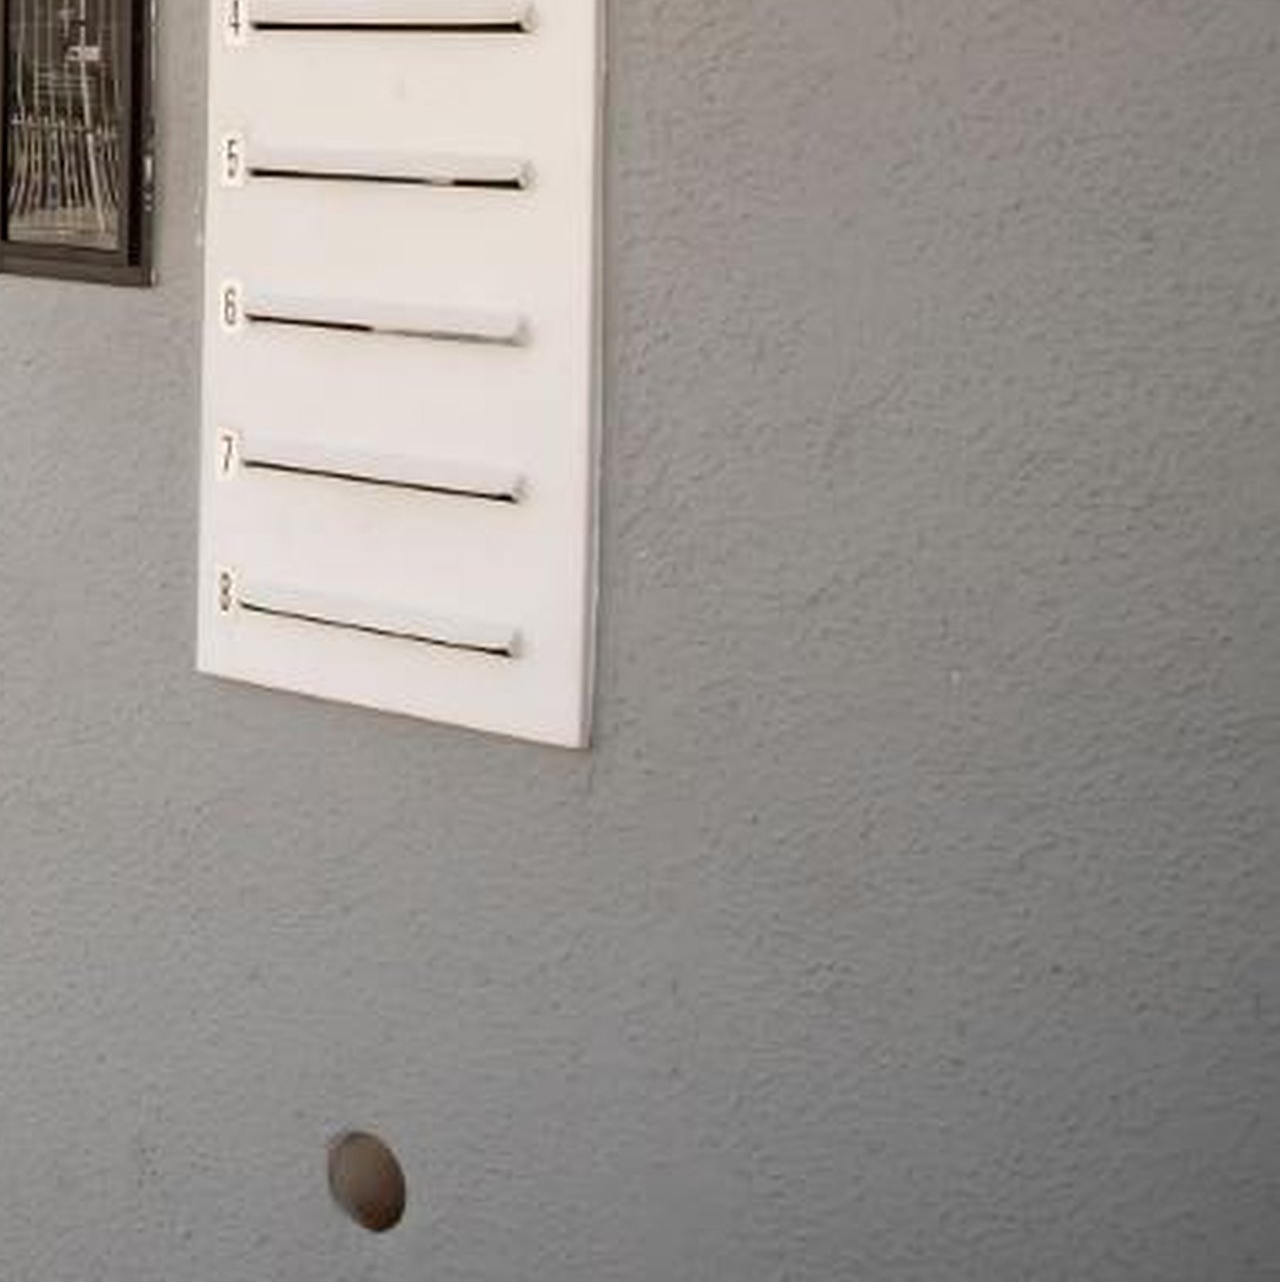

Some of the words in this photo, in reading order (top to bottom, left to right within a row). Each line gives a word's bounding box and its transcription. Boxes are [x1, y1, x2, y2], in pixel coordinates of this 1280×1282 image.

[226, 139, 239, 178] 5
[223, 287, 237, 326] 6
[221, 435, 234, 472] 7
[218, 571, 232, 612] 8
